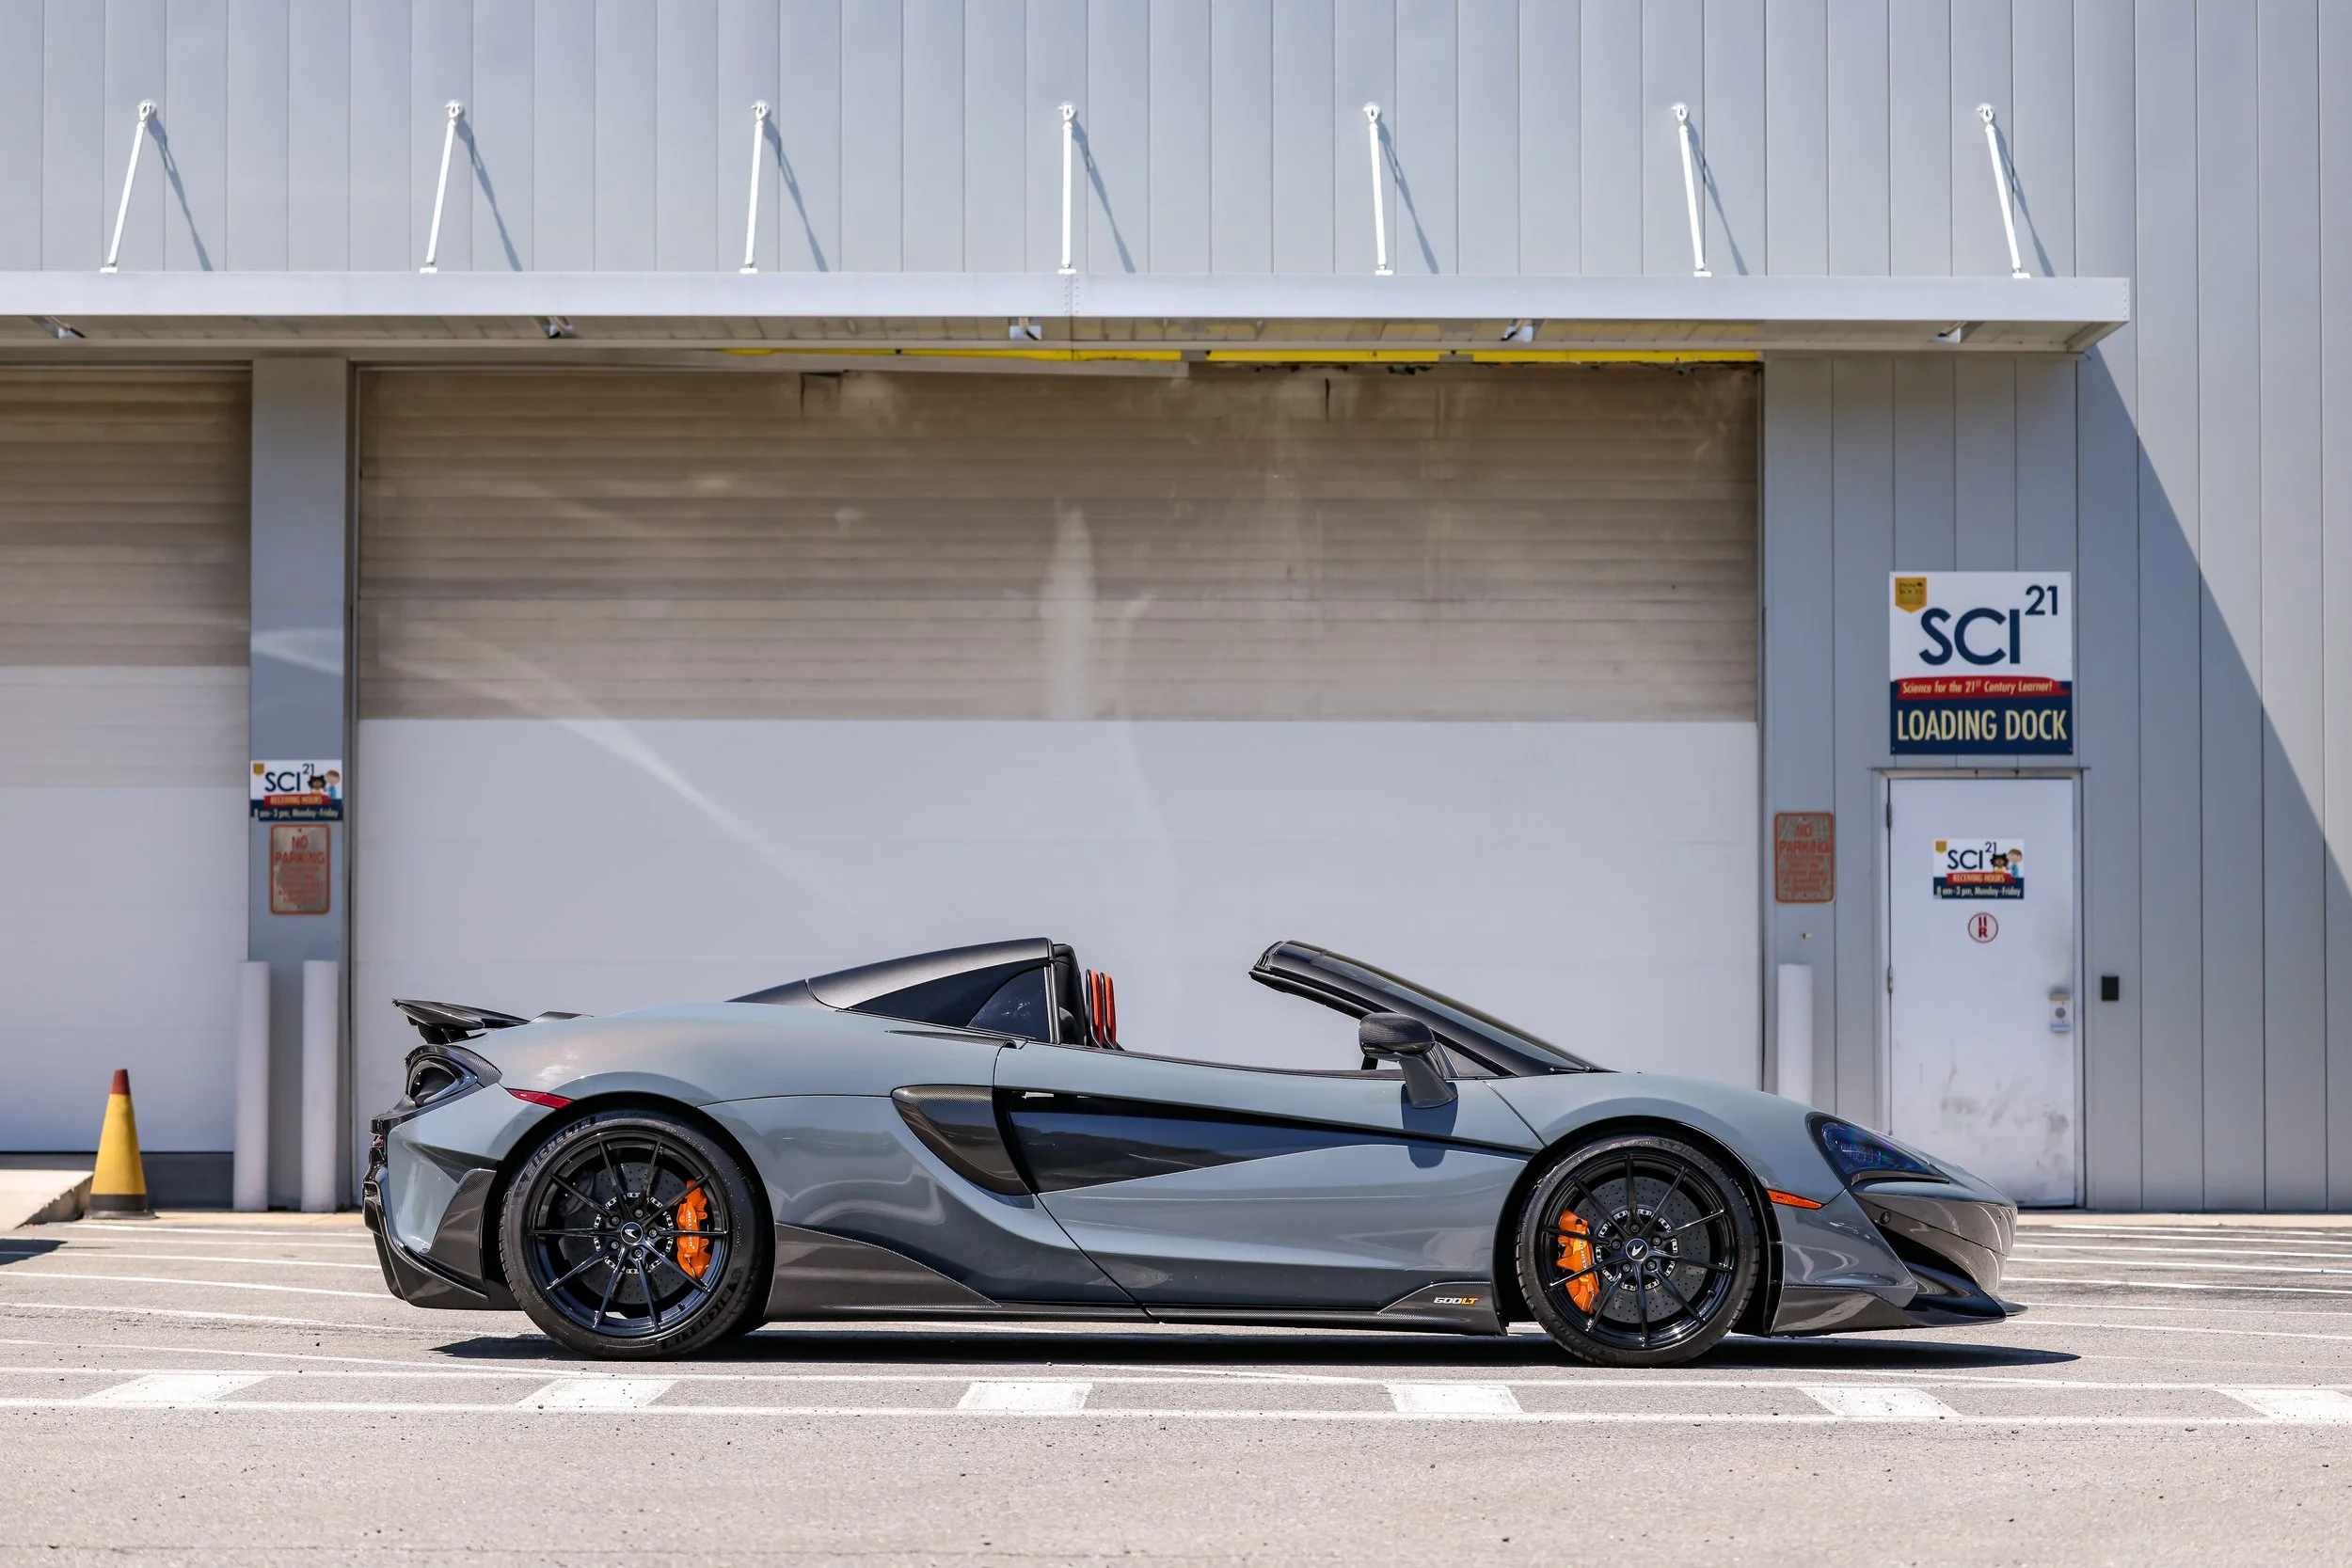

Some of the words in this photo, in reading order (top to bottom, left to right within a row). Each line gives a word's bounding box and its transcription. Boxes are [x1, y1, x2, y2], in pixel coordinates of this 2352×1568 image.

[1918, 607, 2021, 666] SCI
[2025, 584, 2058, 616] 21
[1902, 681, 1932, 694] Science
[1934, 680, 1947, 693] for
[1949, 680, 1963, 693] the
[1984, 680, 2015, 695] Century
[2018, 680, 2053, 693] Learner!
[1898, 709, 1997, 741] LOADING
[2005, 709, 2068, 741] DOCK
[264, 771, 301, 793] SCI
[302, 763, 315, 776] 21
[292, 834, 310, 849] NO
[1947, 849, 1984, 870] SCI
[1985, 841, 1997, 854] 21
[275, 850, 326, 864] PARKING
[1979, 927, 1988, 938] R
[525, 1117, 593, 1178] MICHELIN
[1433, 1296, 1479, 1305] 600LT
[665, 1288, 733, 1347] MICHELIN
